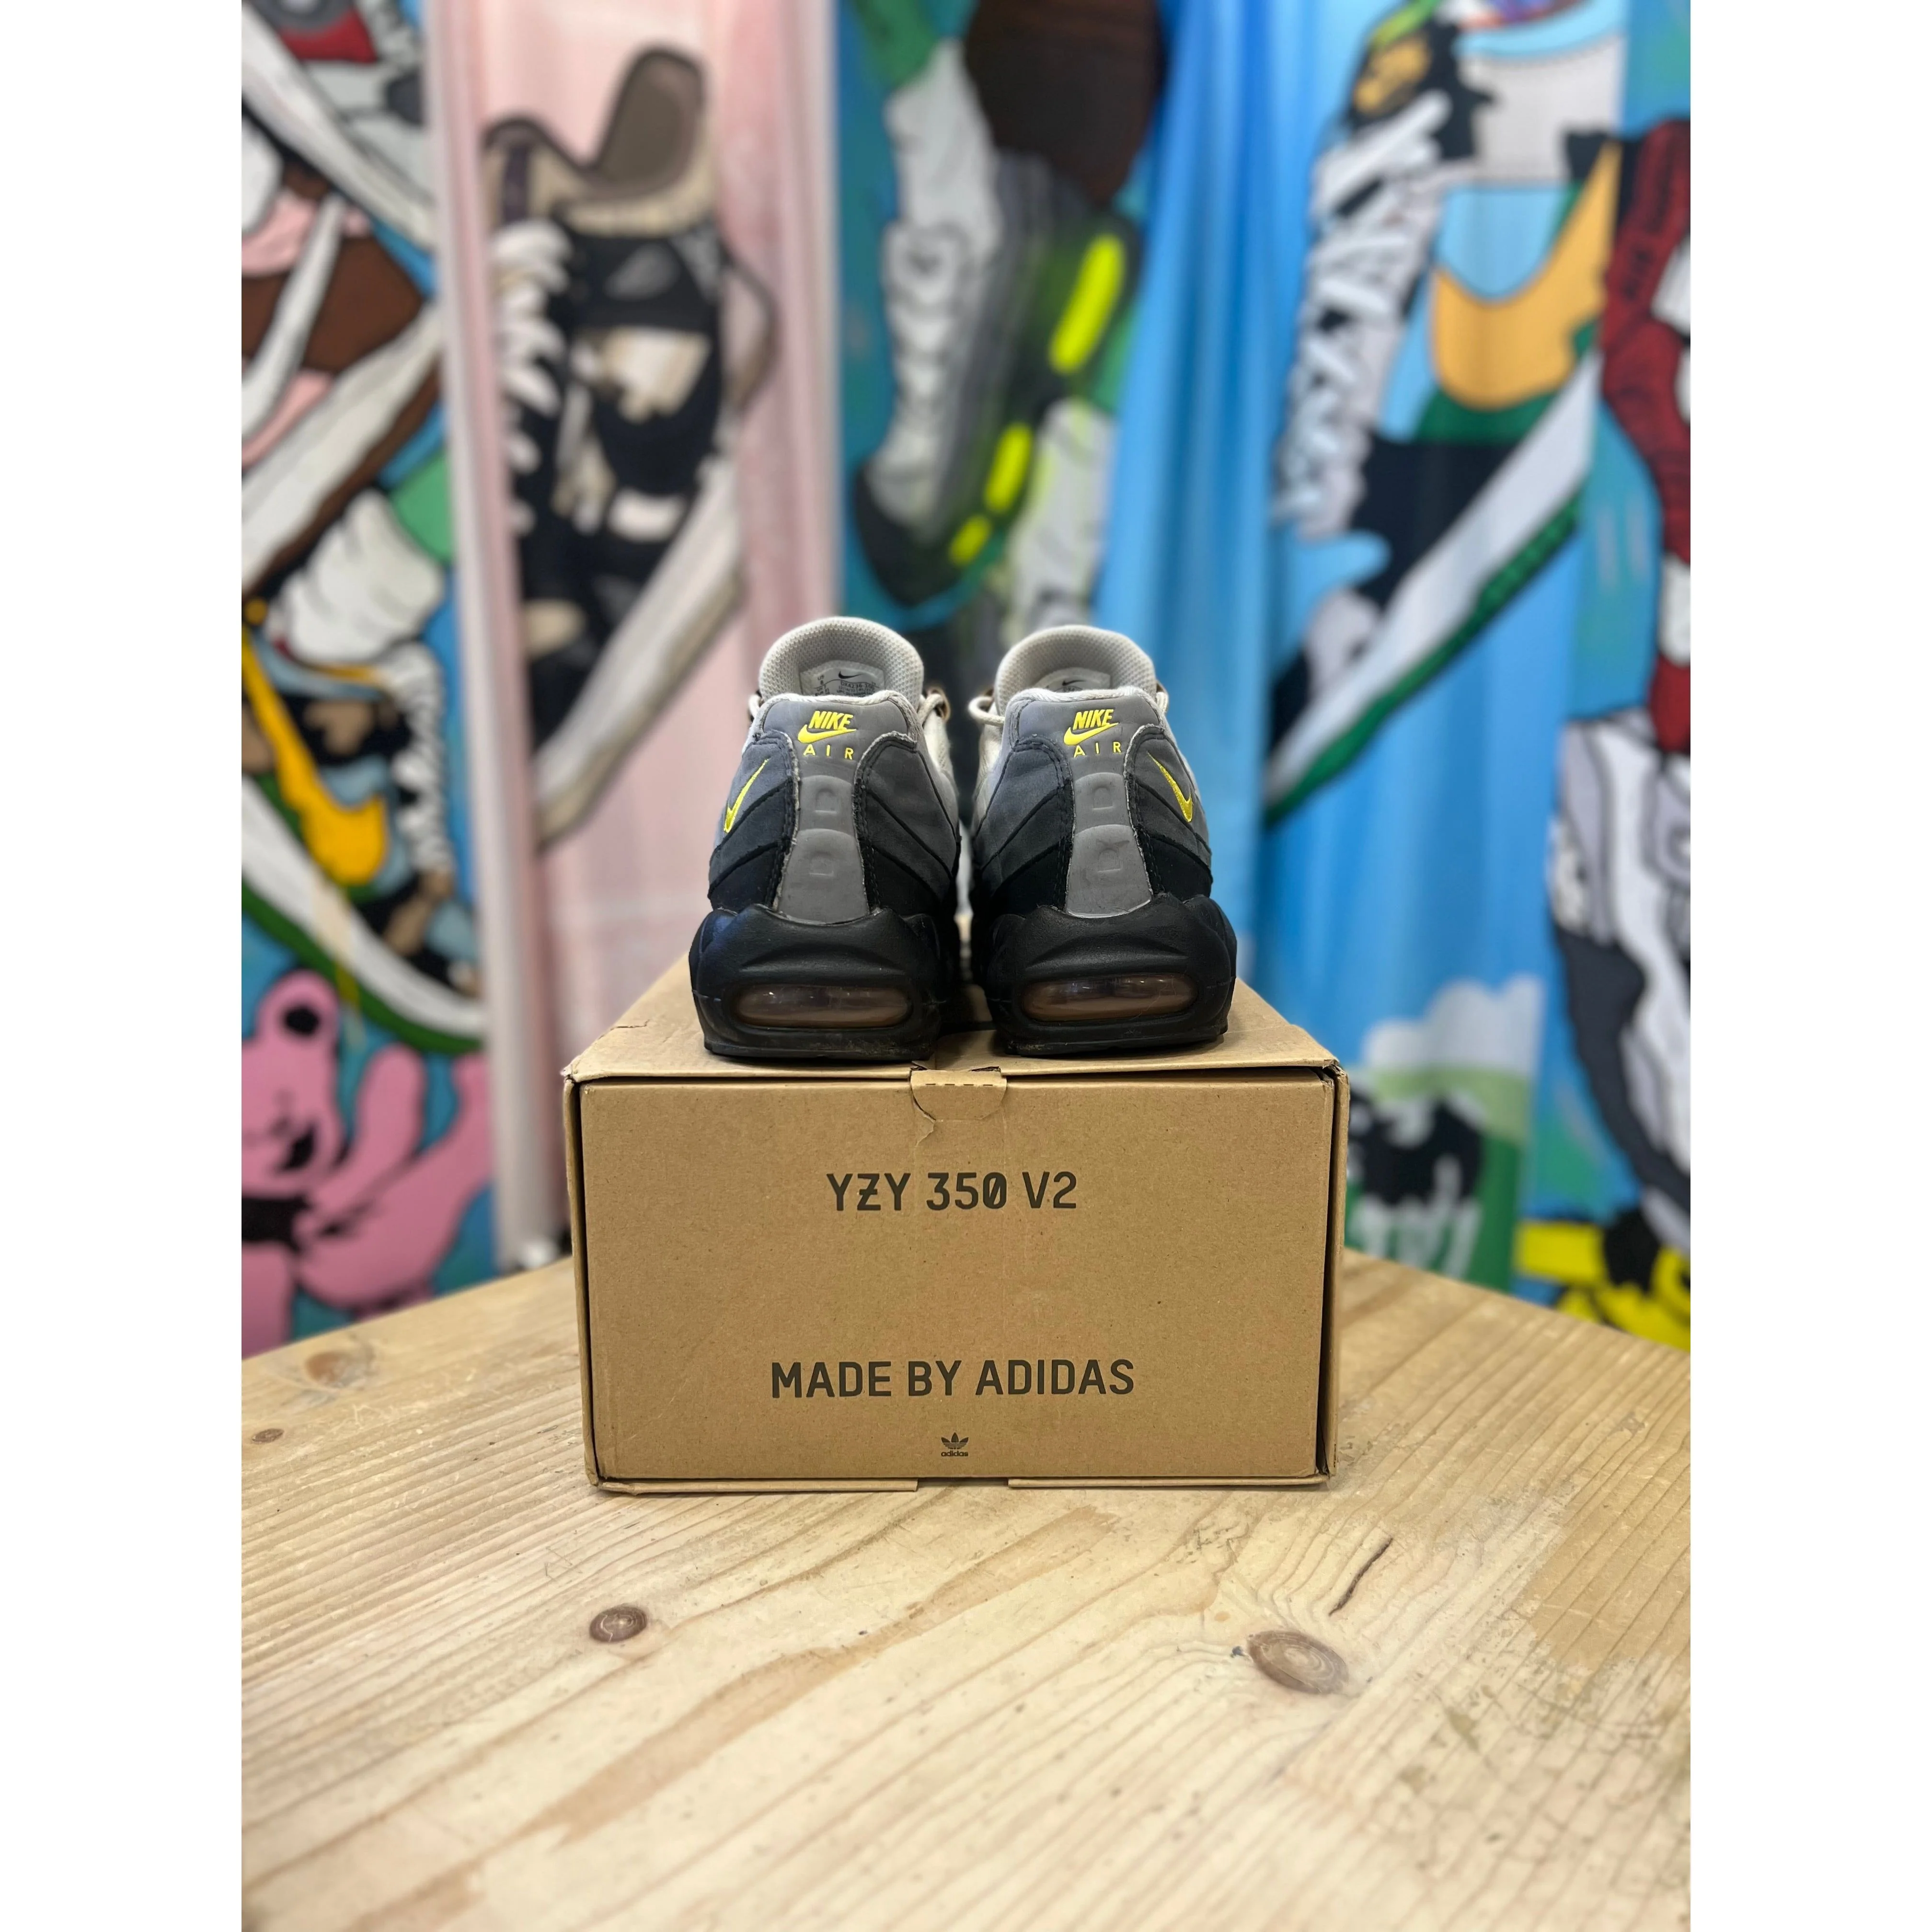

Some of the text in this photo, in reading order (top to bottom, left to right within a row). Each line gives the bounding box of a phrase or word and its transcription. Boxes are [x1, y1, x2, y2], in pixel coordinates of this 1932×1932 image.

[808, 711, 853, 731] NIKE
[1073, 709, 1114, 731] NIKE
[804, 744, 854, 759] AIR
[1073, 741, 1121, 758] AIR
[926, 1172, 1007, 1211] 350
[1022, 1171, 1077, 1209] V2
[771, 1359, 1134, 1399] MADE BY ADIDAS
